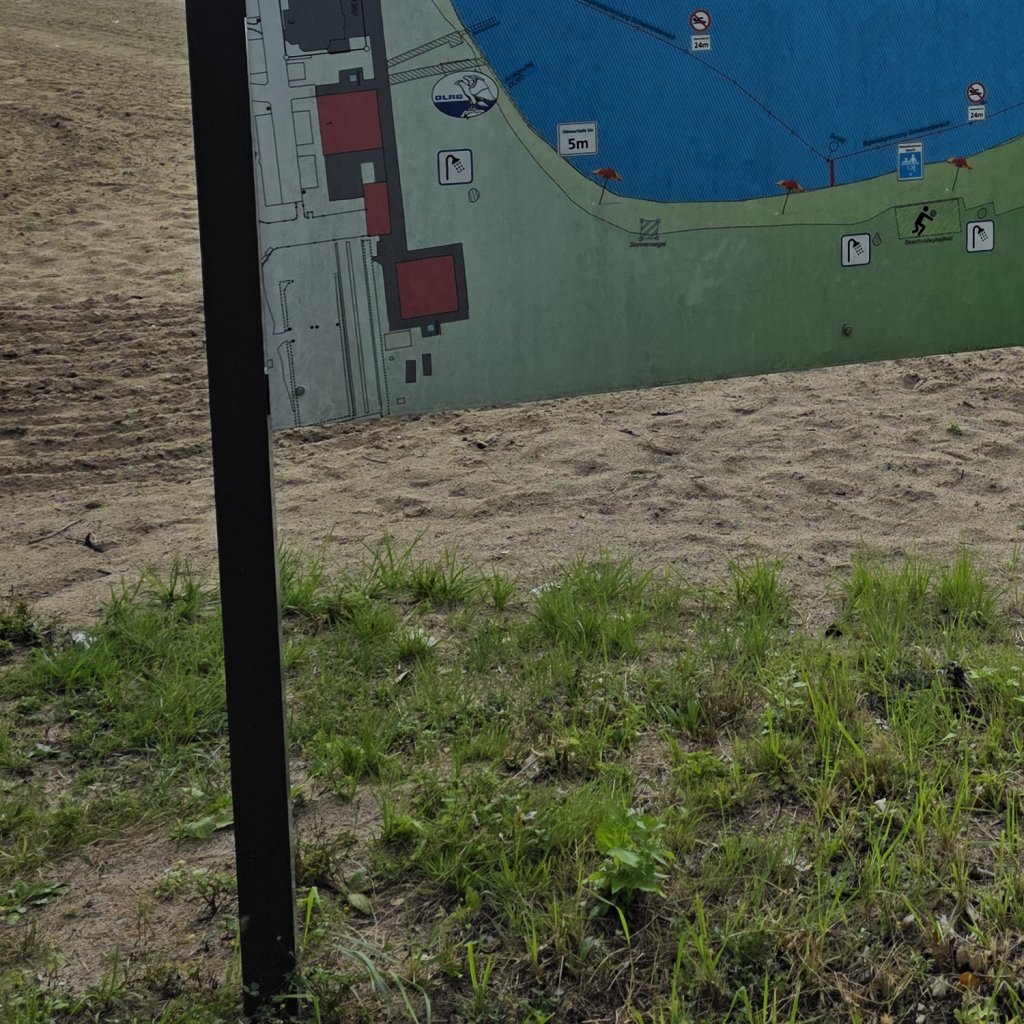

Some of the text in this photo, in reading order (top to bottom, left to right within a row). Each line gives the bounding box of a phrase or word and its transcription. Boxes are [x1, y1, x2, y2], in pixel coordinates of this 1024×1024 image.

[693, 41, 709, 49] 24m
[435, 93, 464, 101] DLRG
[970, 111, 984, 119] 24m
[568, 138, 589, 150] 5m
